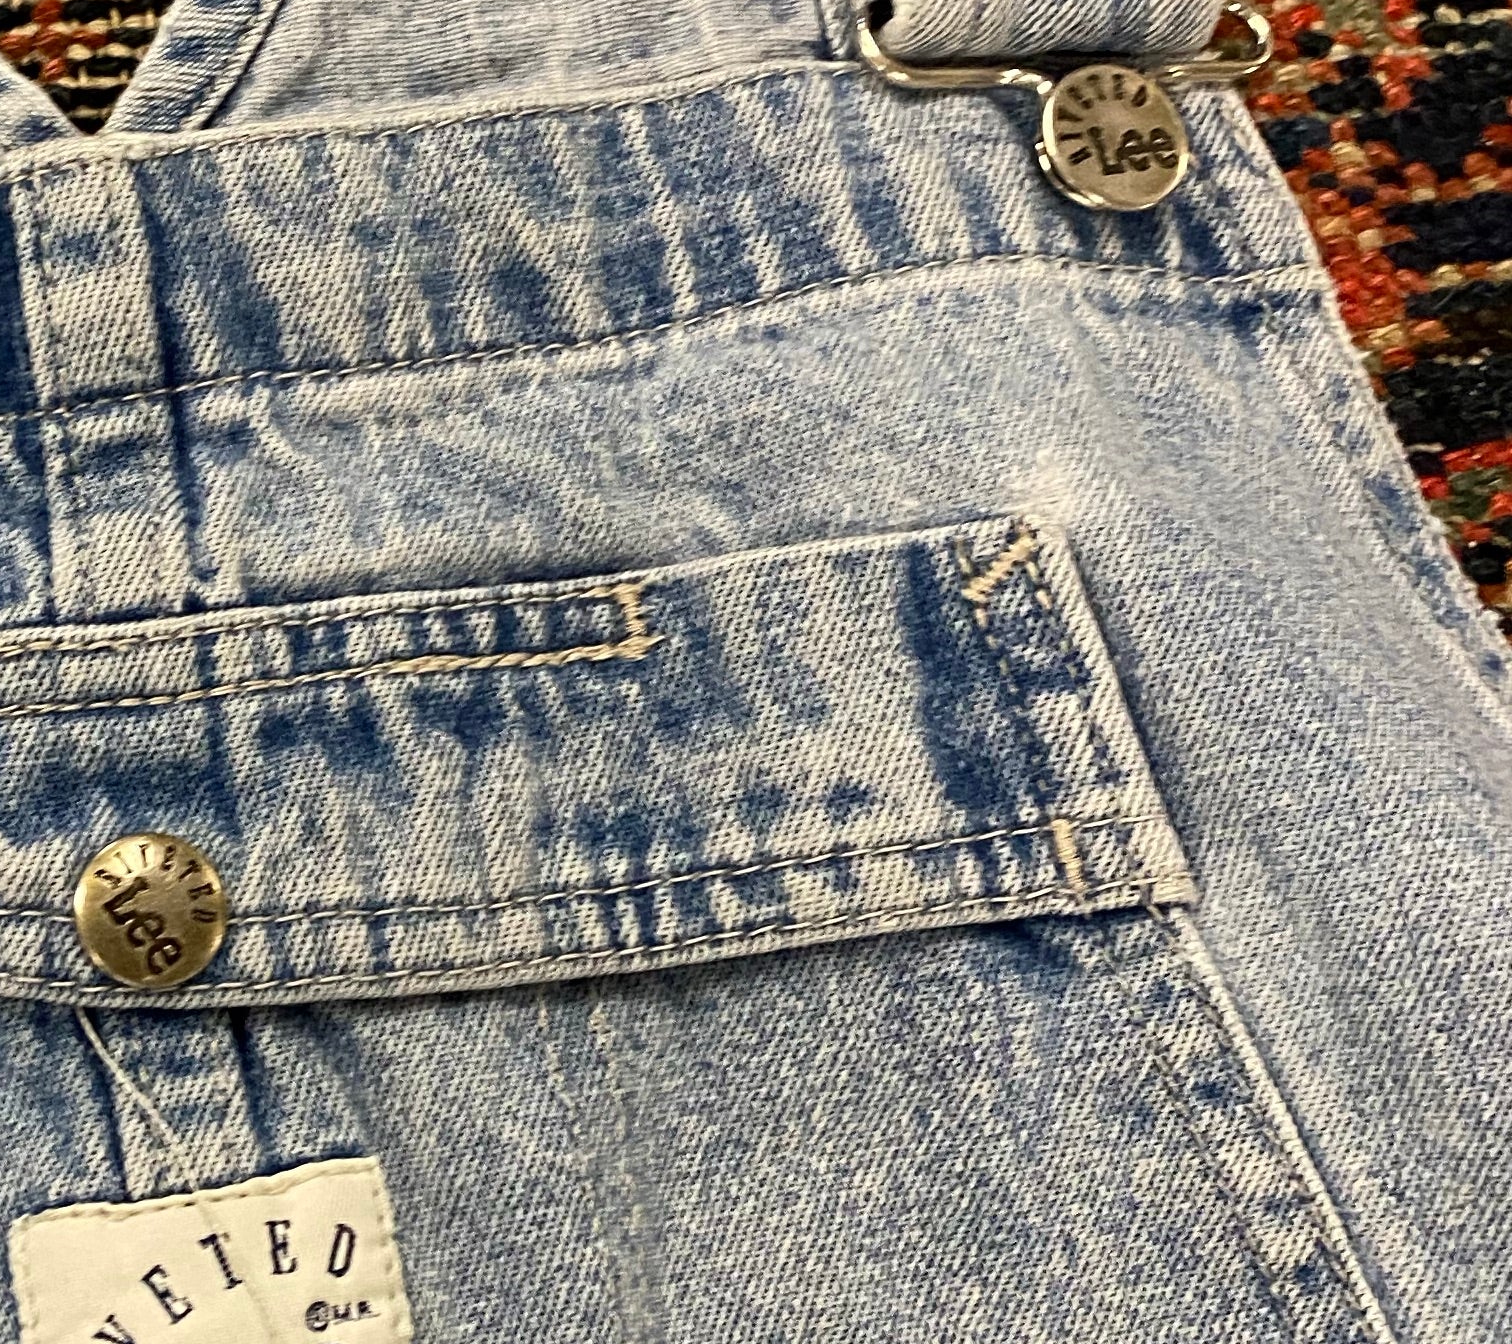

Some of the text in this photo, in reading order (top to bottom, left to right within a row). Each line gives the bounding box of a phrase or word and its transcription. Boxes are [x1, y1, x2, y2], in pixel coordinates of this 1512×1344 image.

[1087, 126, 1178, 175] Lee
[94, 843, 217, 923] RIVETED
[103, 876, 182, 974] Lee
